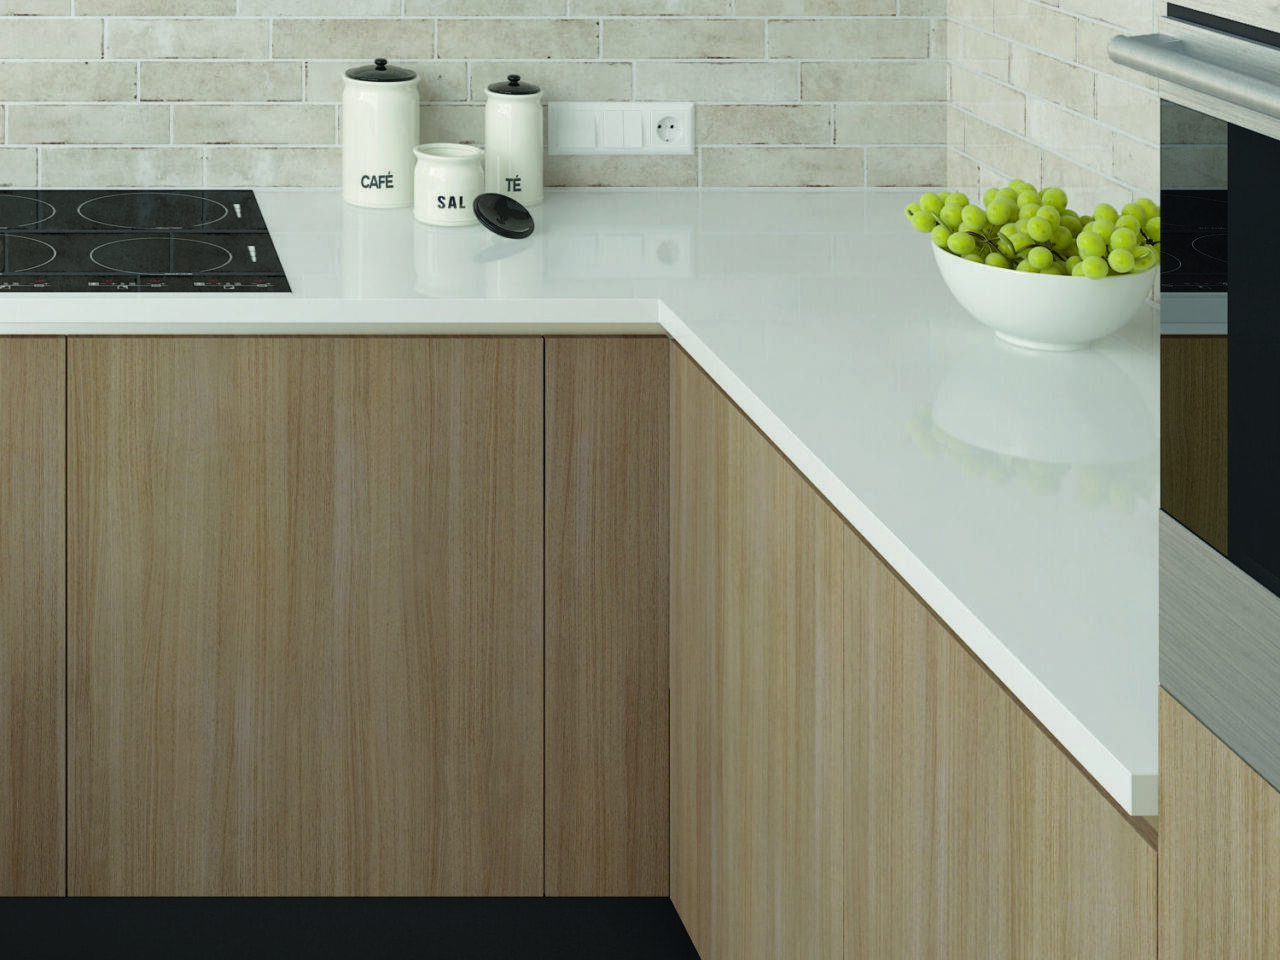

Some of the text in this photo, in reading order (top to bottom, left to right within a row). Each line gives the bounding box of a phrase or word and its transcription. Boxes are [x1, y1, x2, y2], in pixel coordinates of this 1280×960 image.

[360, 171, 394, 189] CAFÉ
[505, 174, 521, 192] TÉ
[437, 195, 466, 209] SAL
